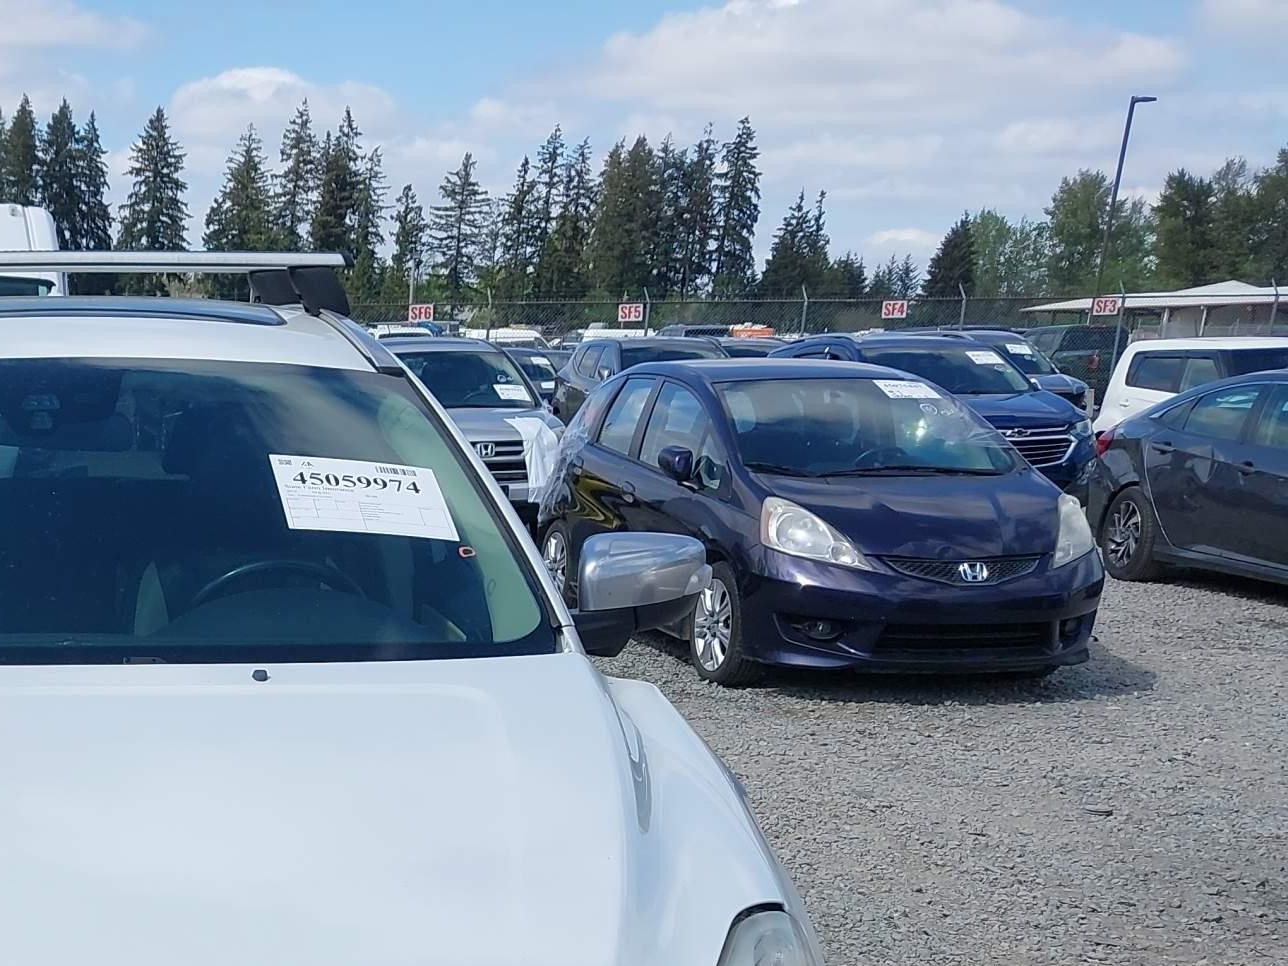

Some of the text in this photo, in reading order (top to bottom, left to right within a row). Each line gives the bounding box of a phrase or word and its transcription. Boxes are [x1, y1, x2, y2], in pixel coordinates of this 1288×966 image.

[411, 306, 432, 321] SF6
[619, 305, 642, 321] SF5
[883, 302, 905, 317] SF4
[1095, 299, 1117, 314] SF3
[292, 471, 422, 494] 45059974
